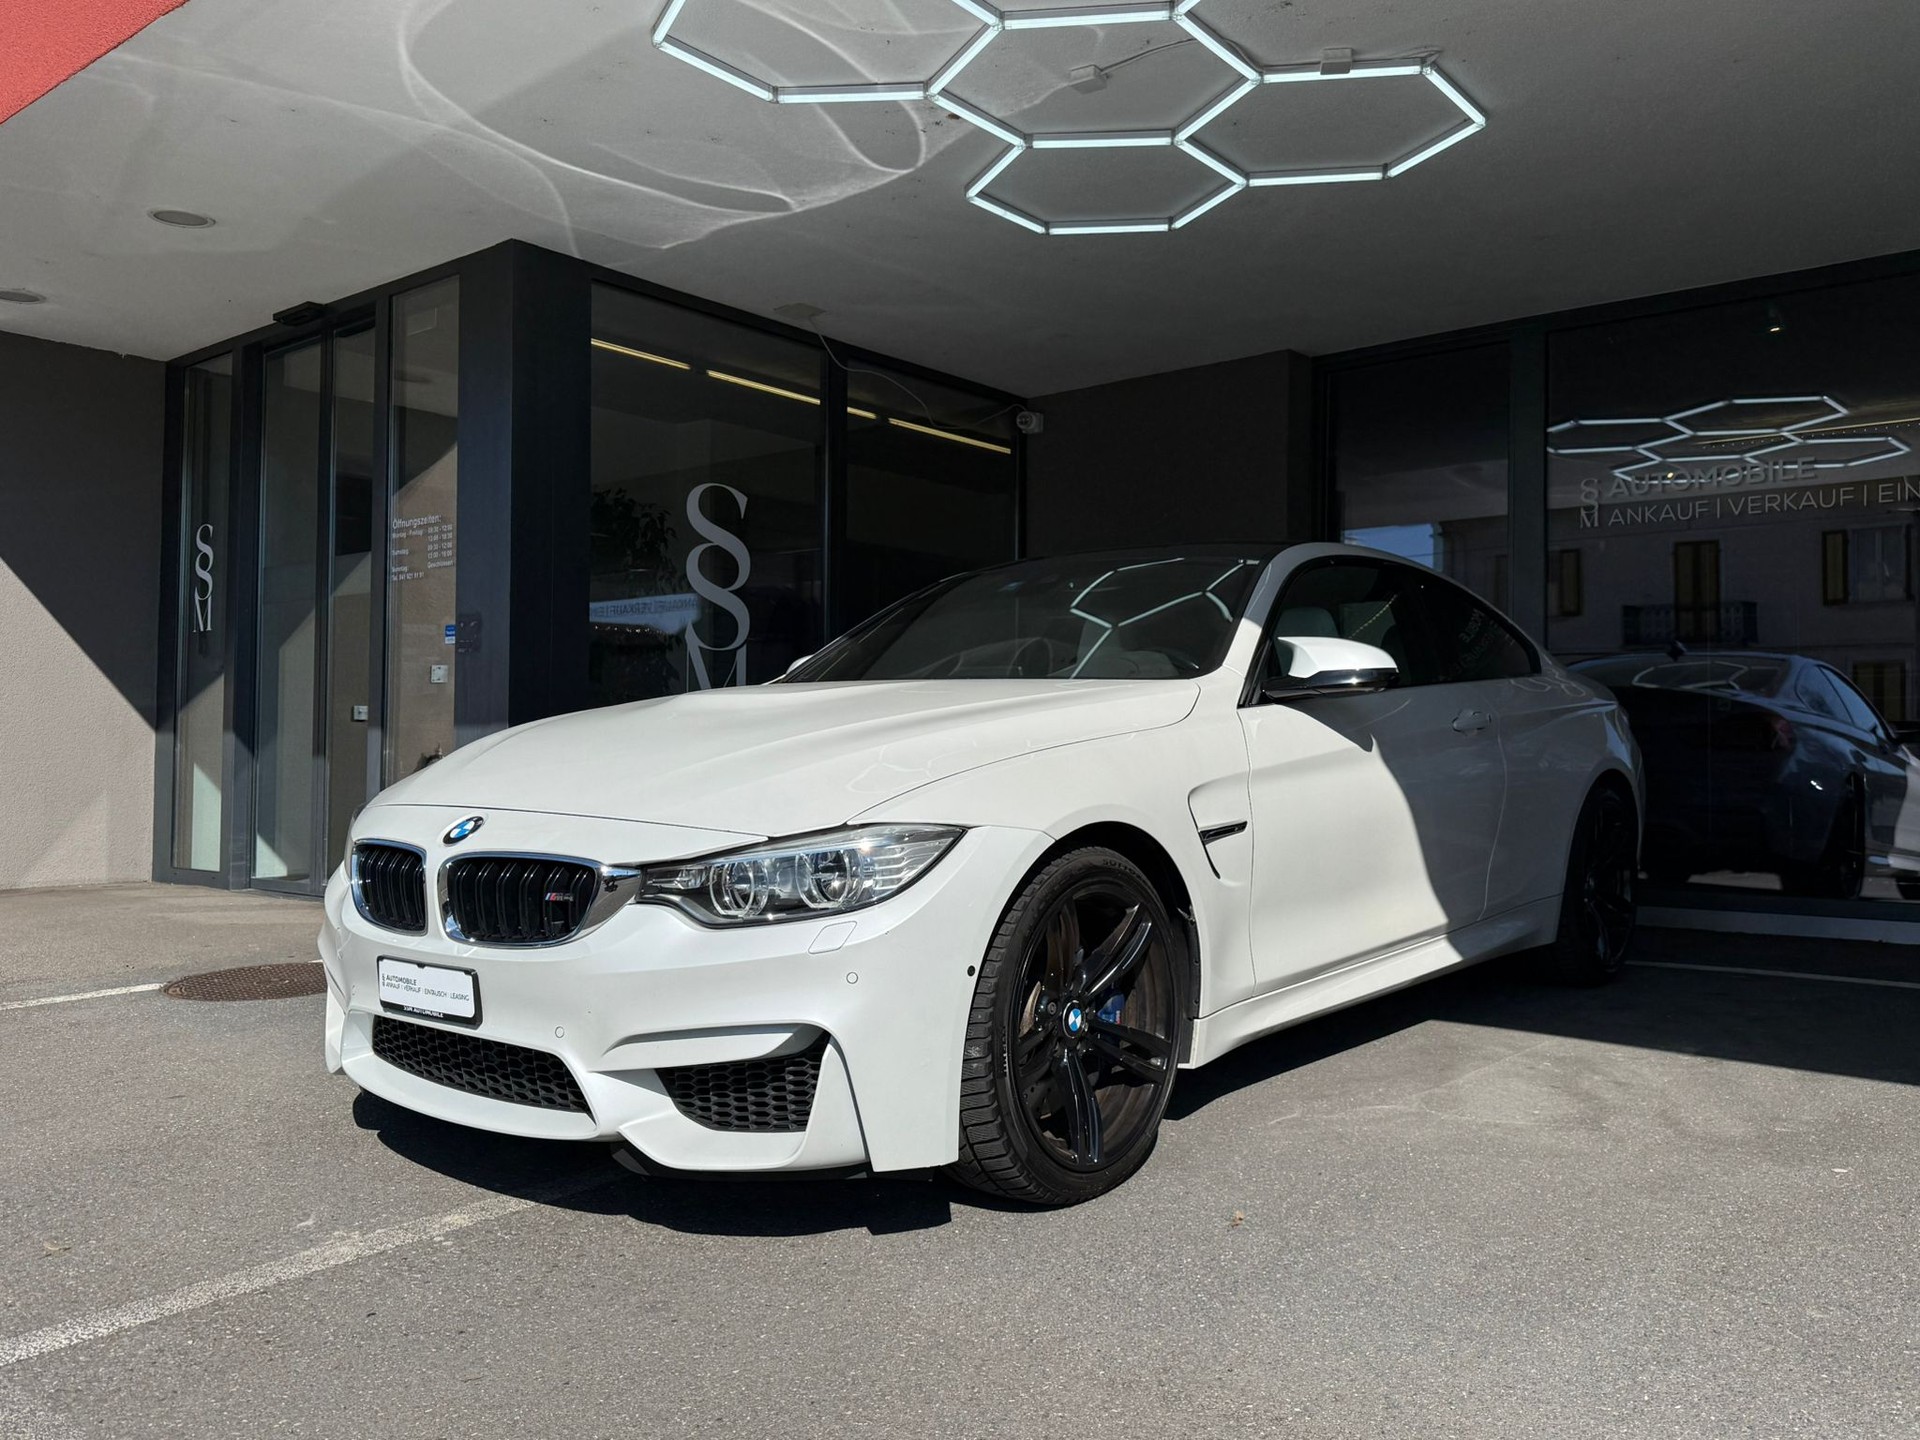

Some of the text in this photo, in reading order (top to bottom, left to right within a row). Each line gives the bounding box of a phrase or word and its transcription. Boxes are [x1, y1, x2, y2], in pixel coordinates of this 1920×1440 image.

[1608, 457, 1817, 497] AUTOMOBILE
[1608, 500, 1711, 527] ANKAUF
[1727, 486, 1855, 517] VERKAUF
[386, 974, 417, 986] AUTOMOBILE
[450, 992, 470, 1001] LEASING
